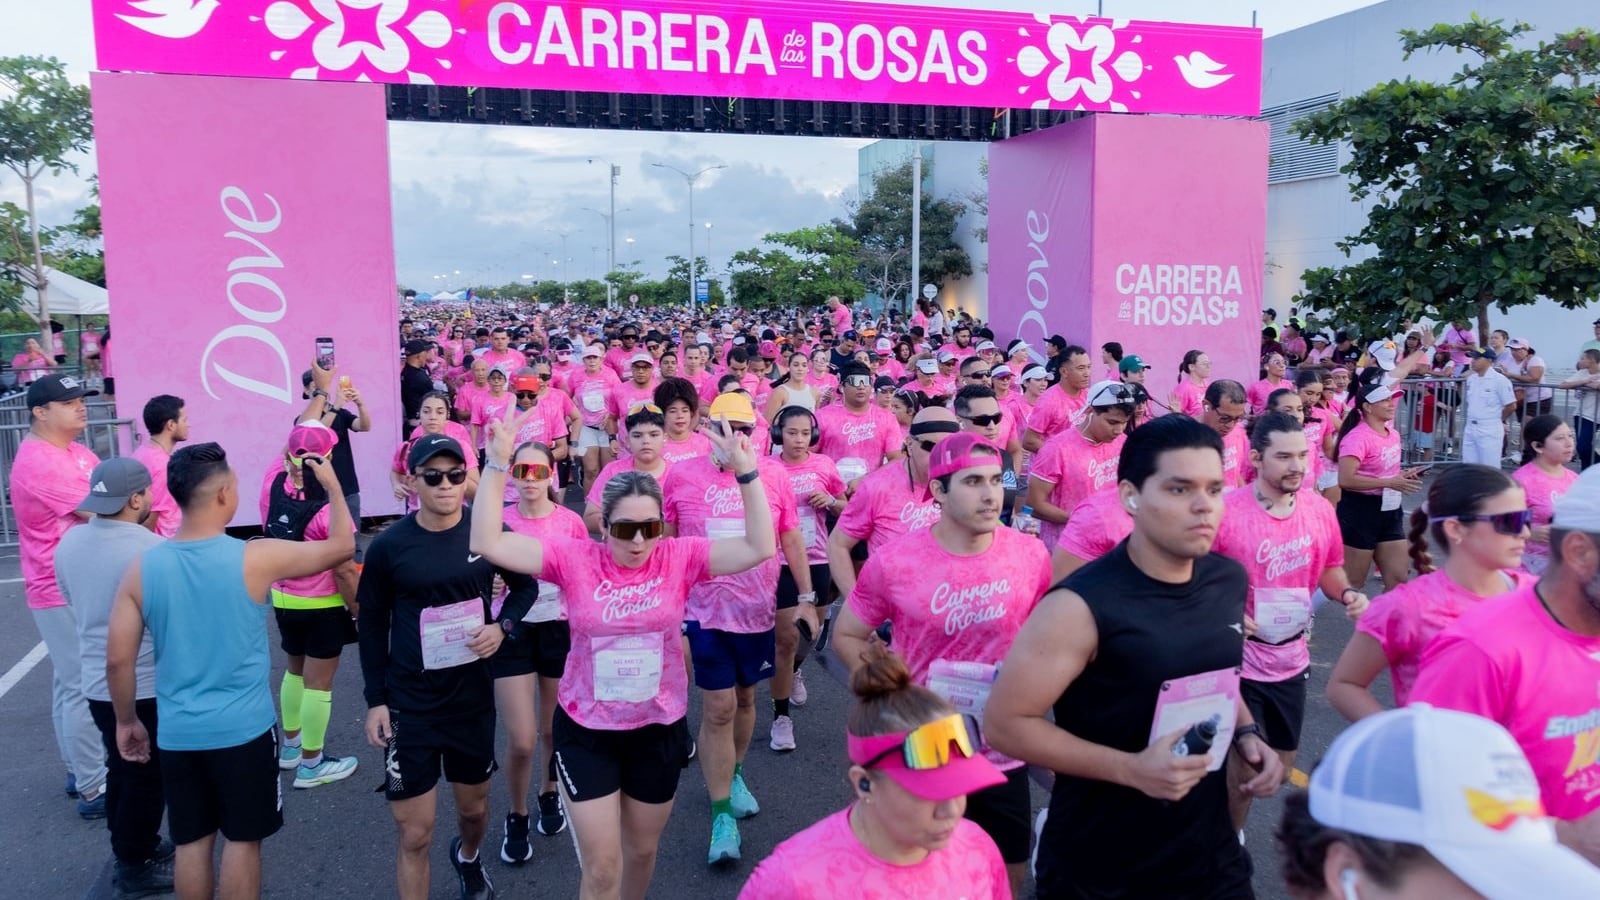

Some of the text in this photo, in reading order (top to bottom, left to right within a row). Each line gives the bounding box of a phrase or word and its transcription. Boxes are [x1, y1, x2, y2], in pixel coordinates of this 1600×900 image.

[487, 2, 777, 76] CARRERA
[783, 29, 806, 47] de
[812, 22, 988, 86] ROSAS
[780, 46, 806, 63] las
[200, 185, 292, 405] Dove
[1016, 209, 1050, 367] Dove
[1115, 263, 1243, 295] CARRERA
[1133, 295, 1224, 327] ROSAS
[1256, 534, 1313, 564] Carrera
[1266, 553, 1312, 581] Rosas
[593, 575, 663, 602] Carrera
[930, 578, 1011, 615] Carrera
[602, 594, 662, 624] Rosas
[944, 603, 1007, 636] Rosas
